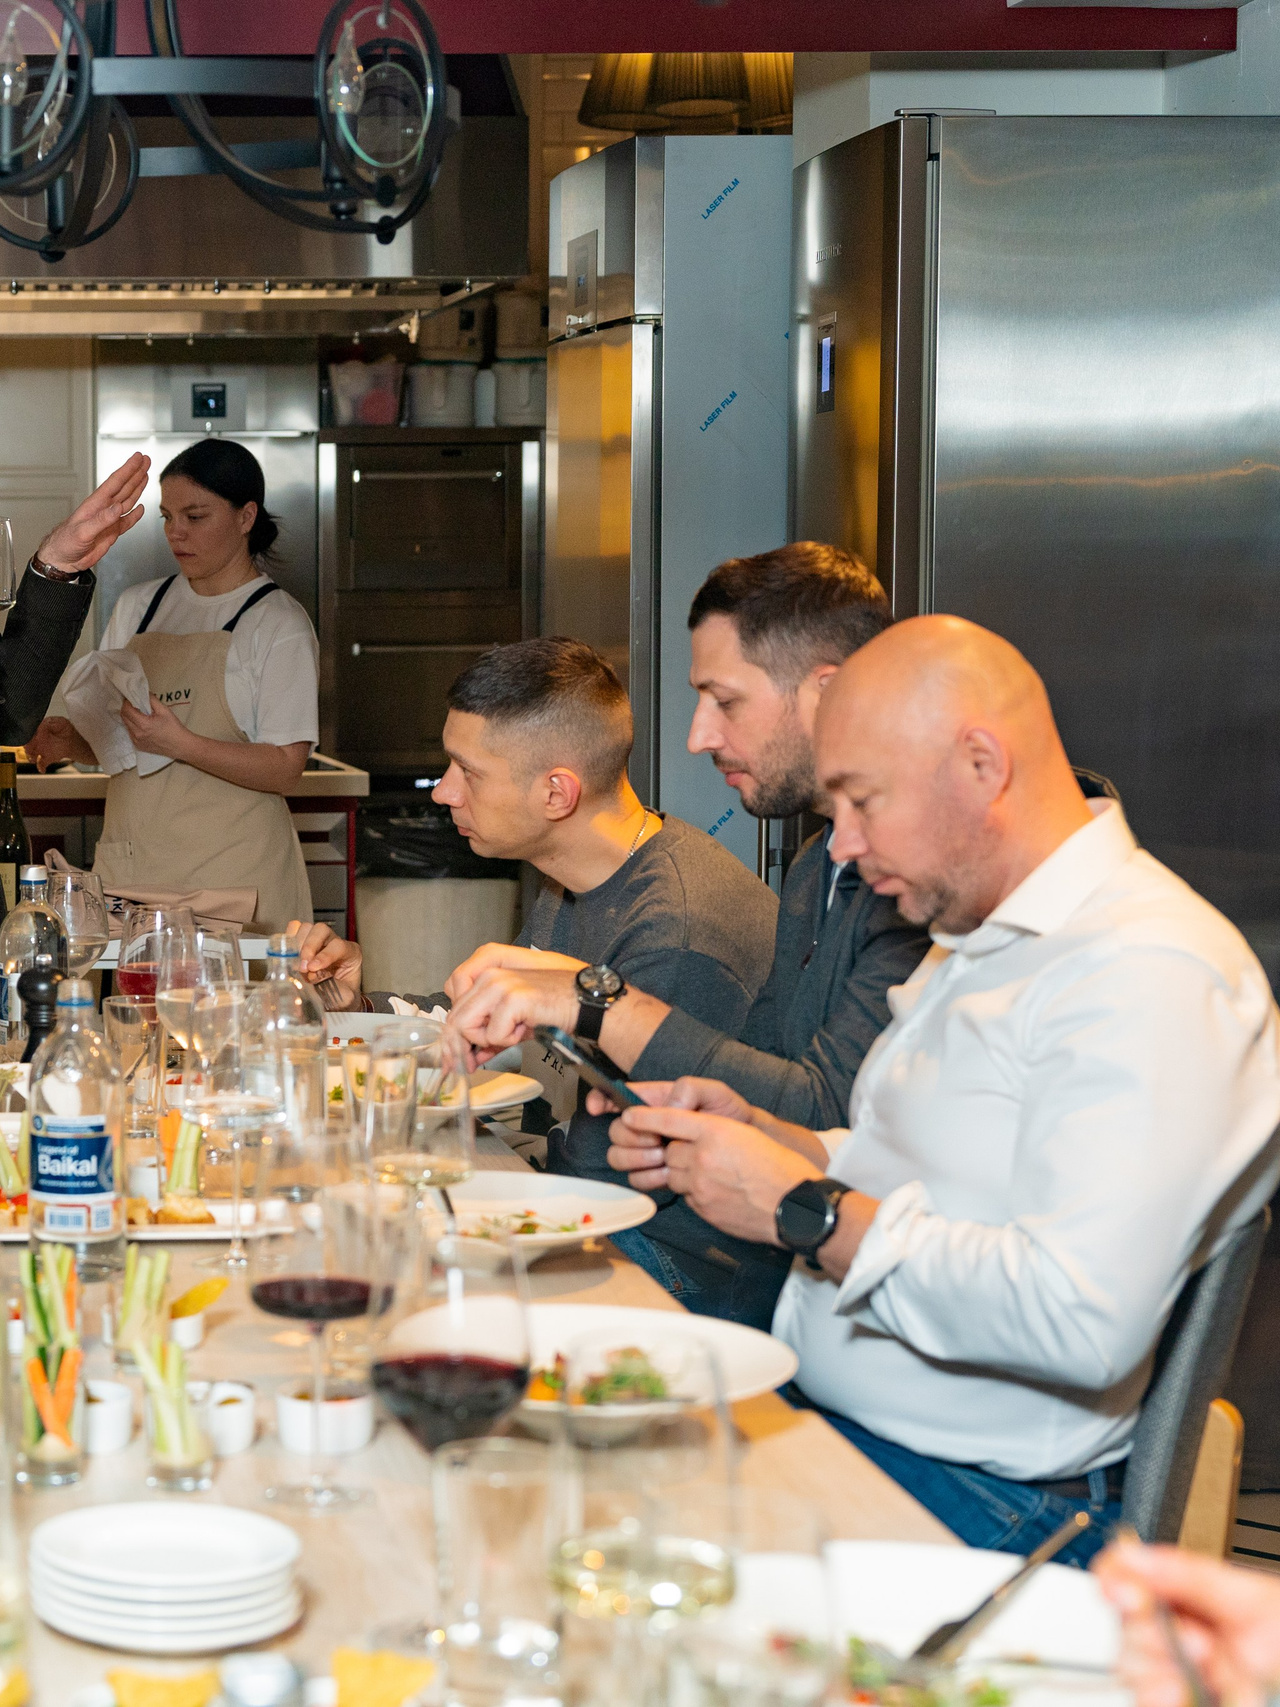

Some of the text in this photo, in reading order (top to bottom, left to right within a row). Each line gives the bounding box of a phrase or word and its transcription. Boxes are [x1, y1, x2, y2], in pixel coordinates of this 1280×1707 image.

[701, 178, 740, 220] LASER FILM
[699, 390, 738, 432] LASER FILM
[154, 688, 191, 702] IKOV
[707, 808, 735, 836] ER FILM
[37, 1154, 99, 1177] Baikal
